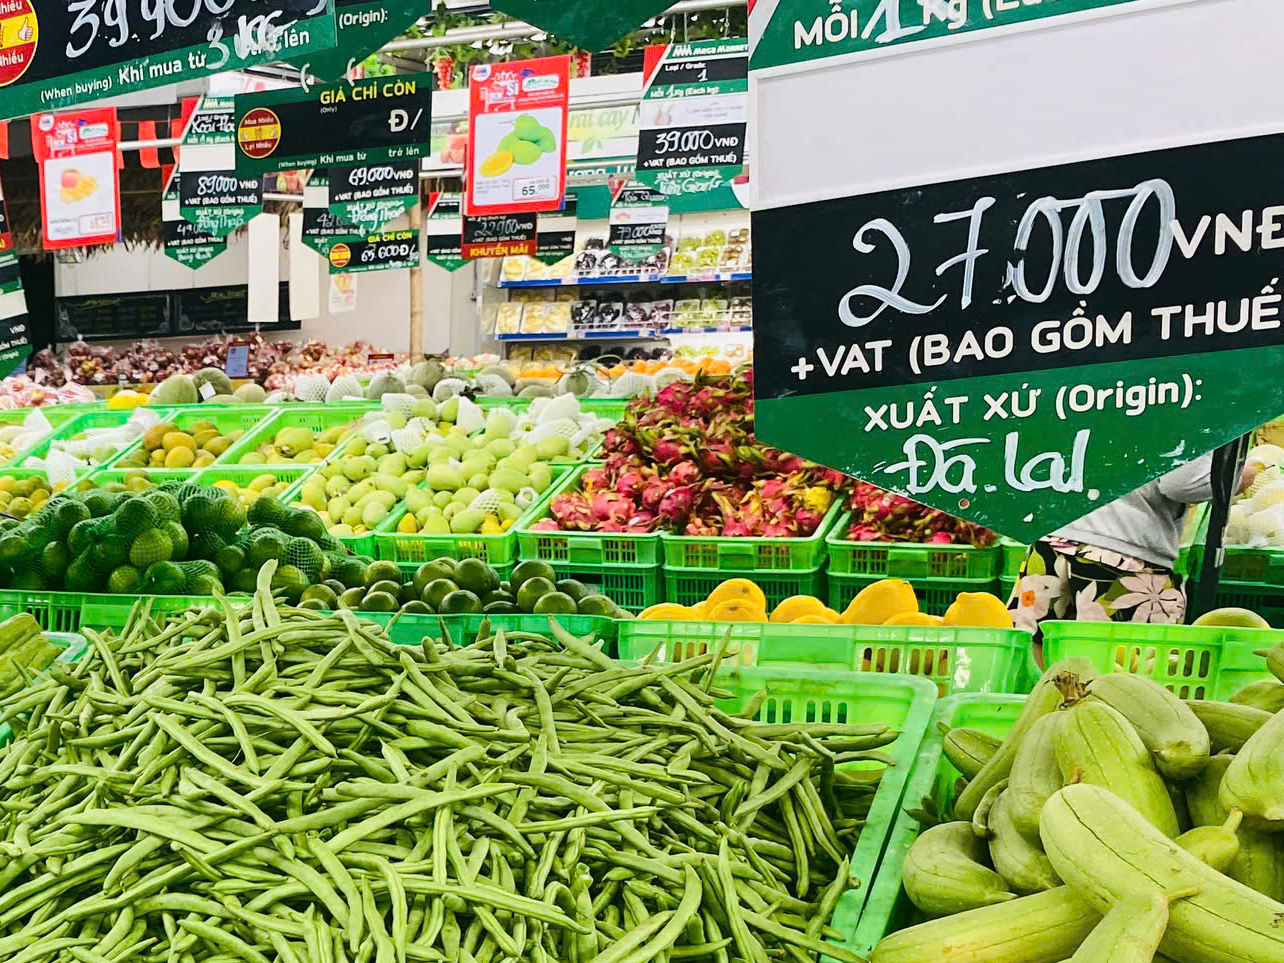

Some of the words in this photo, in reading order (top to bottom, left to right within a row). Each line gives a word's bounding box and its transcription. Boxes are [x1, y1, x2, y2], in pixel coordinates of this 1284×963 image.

[338, 8, 389, 30] (Origin):
[40, 88, 73, 104] (When
[75, 76, 113, 95] buying)
[118, 67, 144, 86] Khi
[149, 59, 183, 76] mua
[284, 29, 310, 48] lên
[320, 86, 346, 105] GIÁ
[351, 81, 378, 101] CHỈ
[382, 79, 416, 98] CÒN
[714, 136, 739, 148] VNĐ
[320, 154, 334, 164] Khi
[335, 154, 354, 163] mua
[643, 158, 665, 168] +VAT
[665, 157, 687, 168] (BAO
[239, 180, 258, 190] VNĐ
[393, 169, 414, 180] VNĐ
[837, 177, 1178, 328] 27.000
[790, 339, 893, 381] +VAT
[908, 325, 1015, 376] (BAO
[1030, 299, 1133, 355] GỒM
[1151, 276, 1282, 342] THUẾ
[863, 384, 970, 434] XUẤT
[983, 382, 1043, 421] XỨ
[1056, 373, 1204, 421] (Origin):
